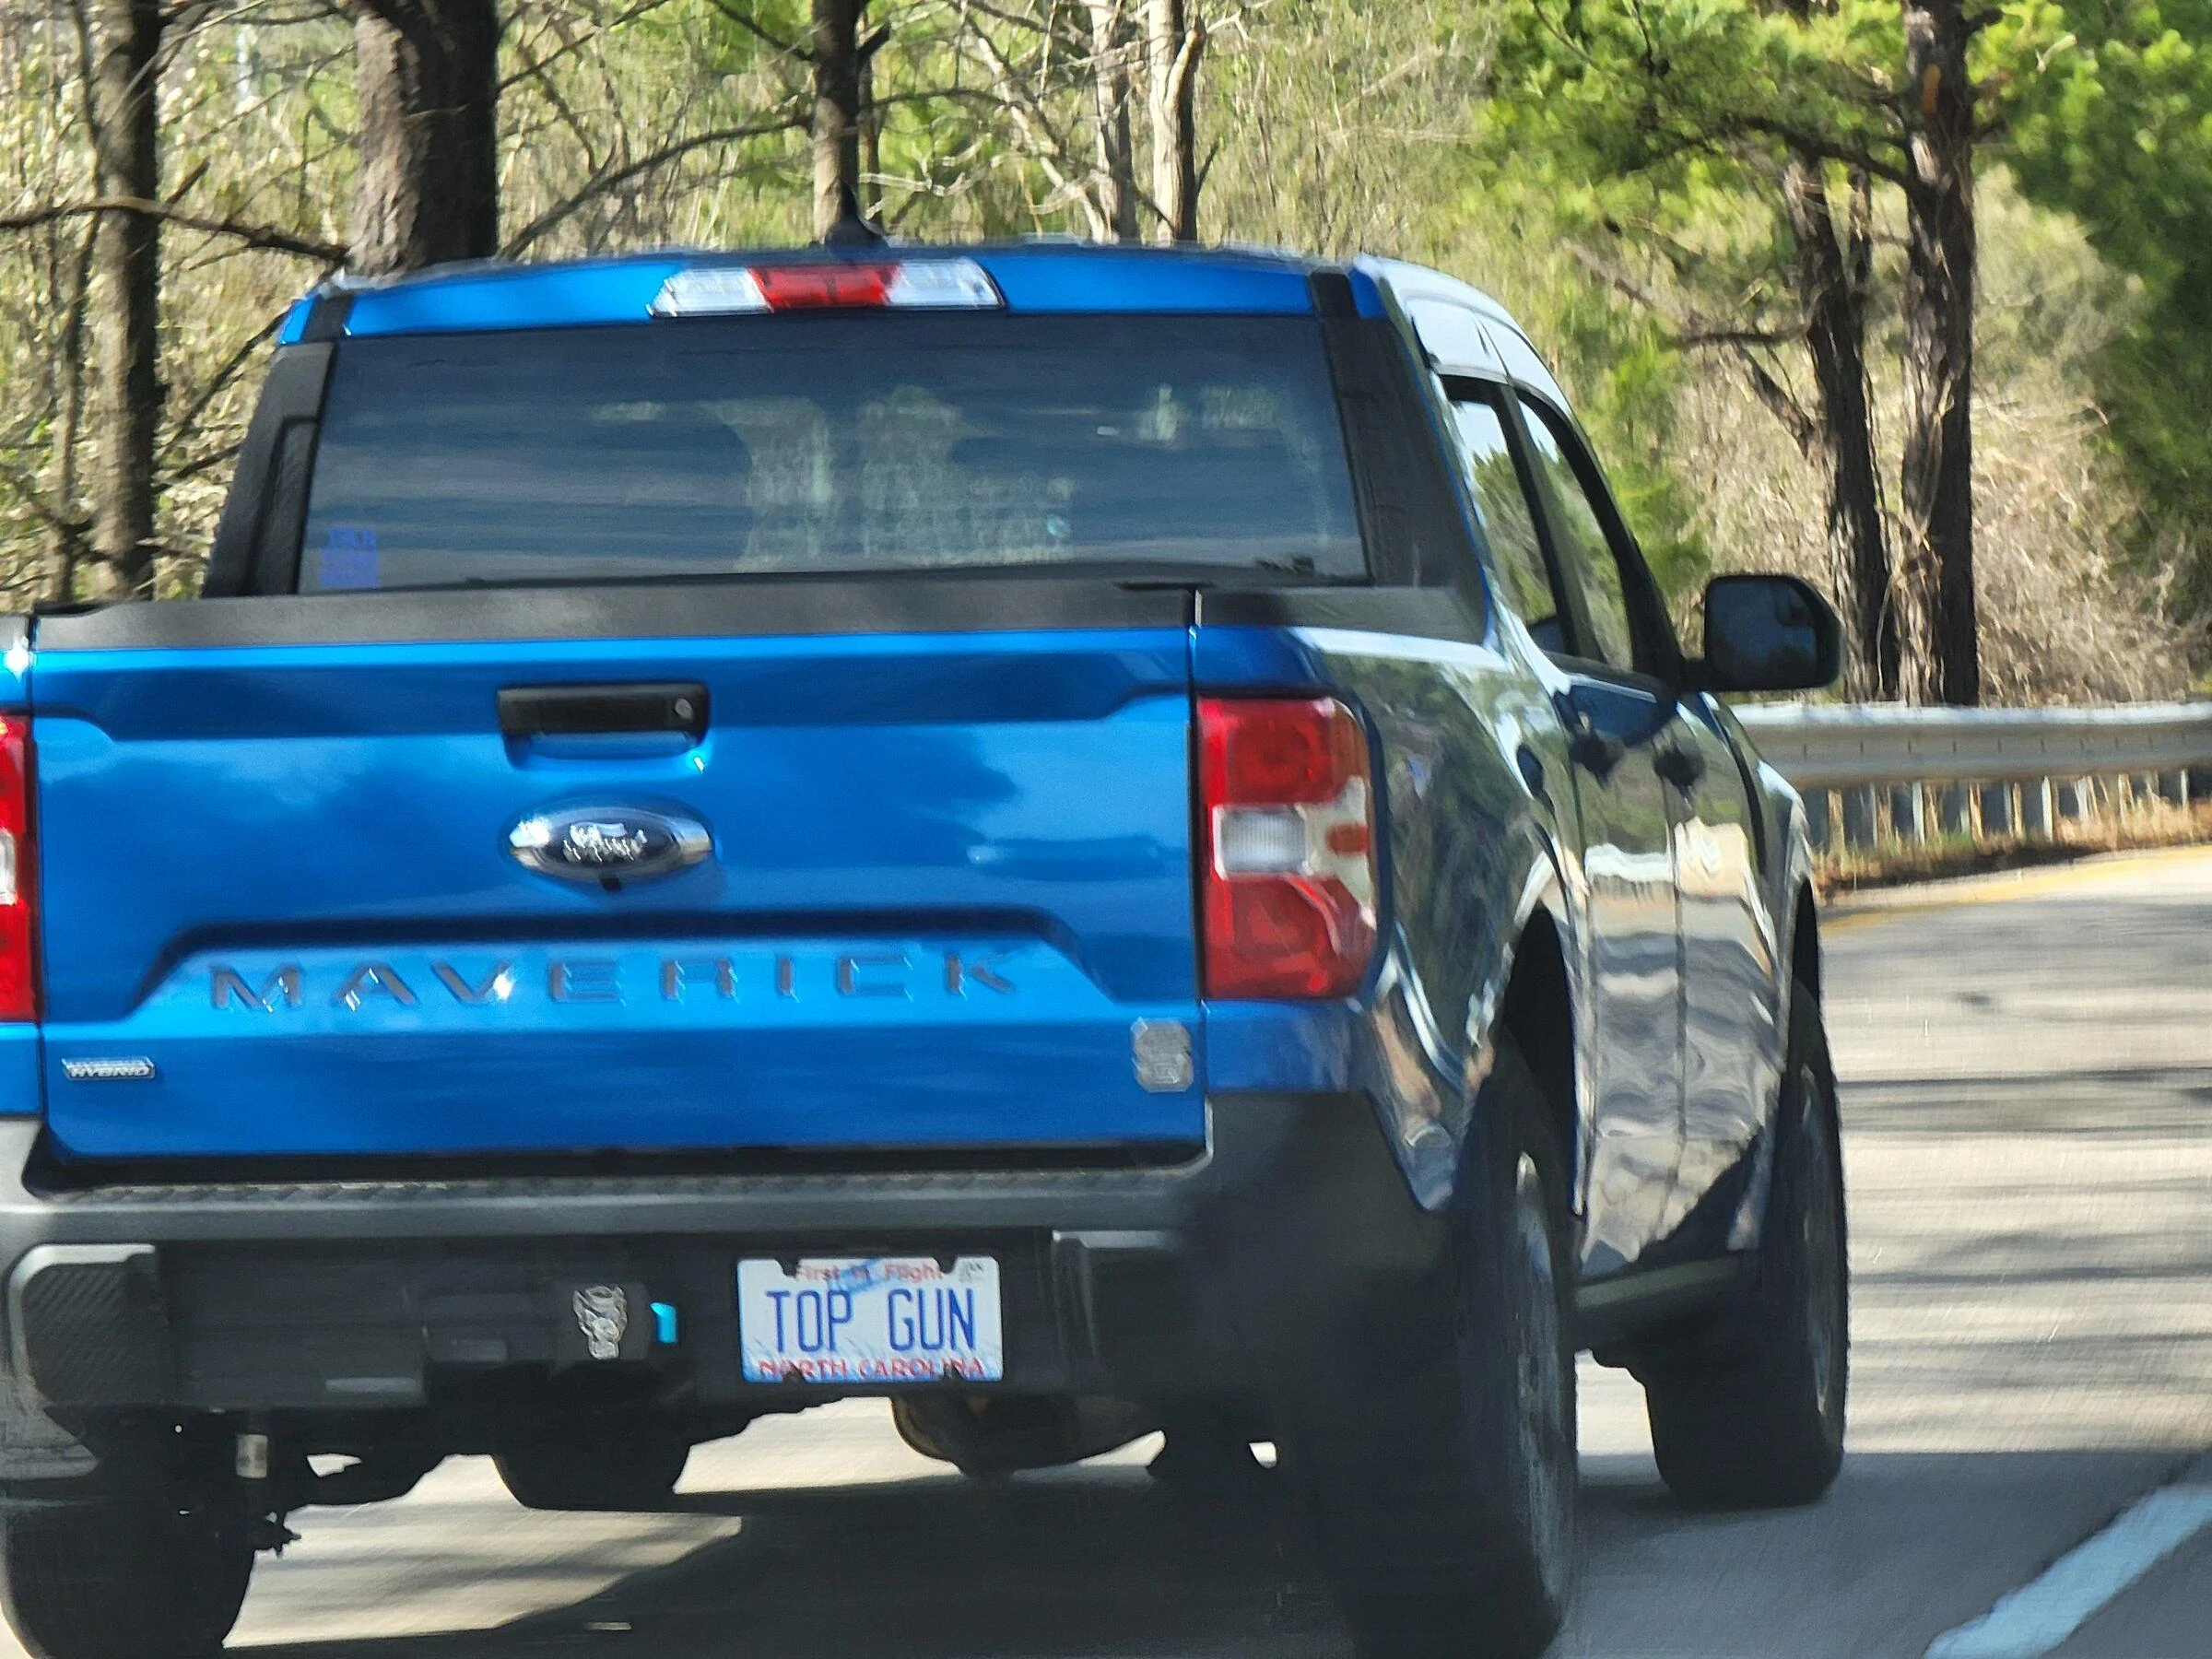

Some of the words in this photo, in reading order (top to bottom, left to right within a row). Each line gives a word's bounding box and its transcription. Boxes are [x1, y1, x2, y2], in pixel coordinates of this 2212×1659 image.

[209, 953, 1017, 1012] MAVERICK
[767, 1290, 853, 1352] TOP
[888, 1288, 976, 1351] GUN
